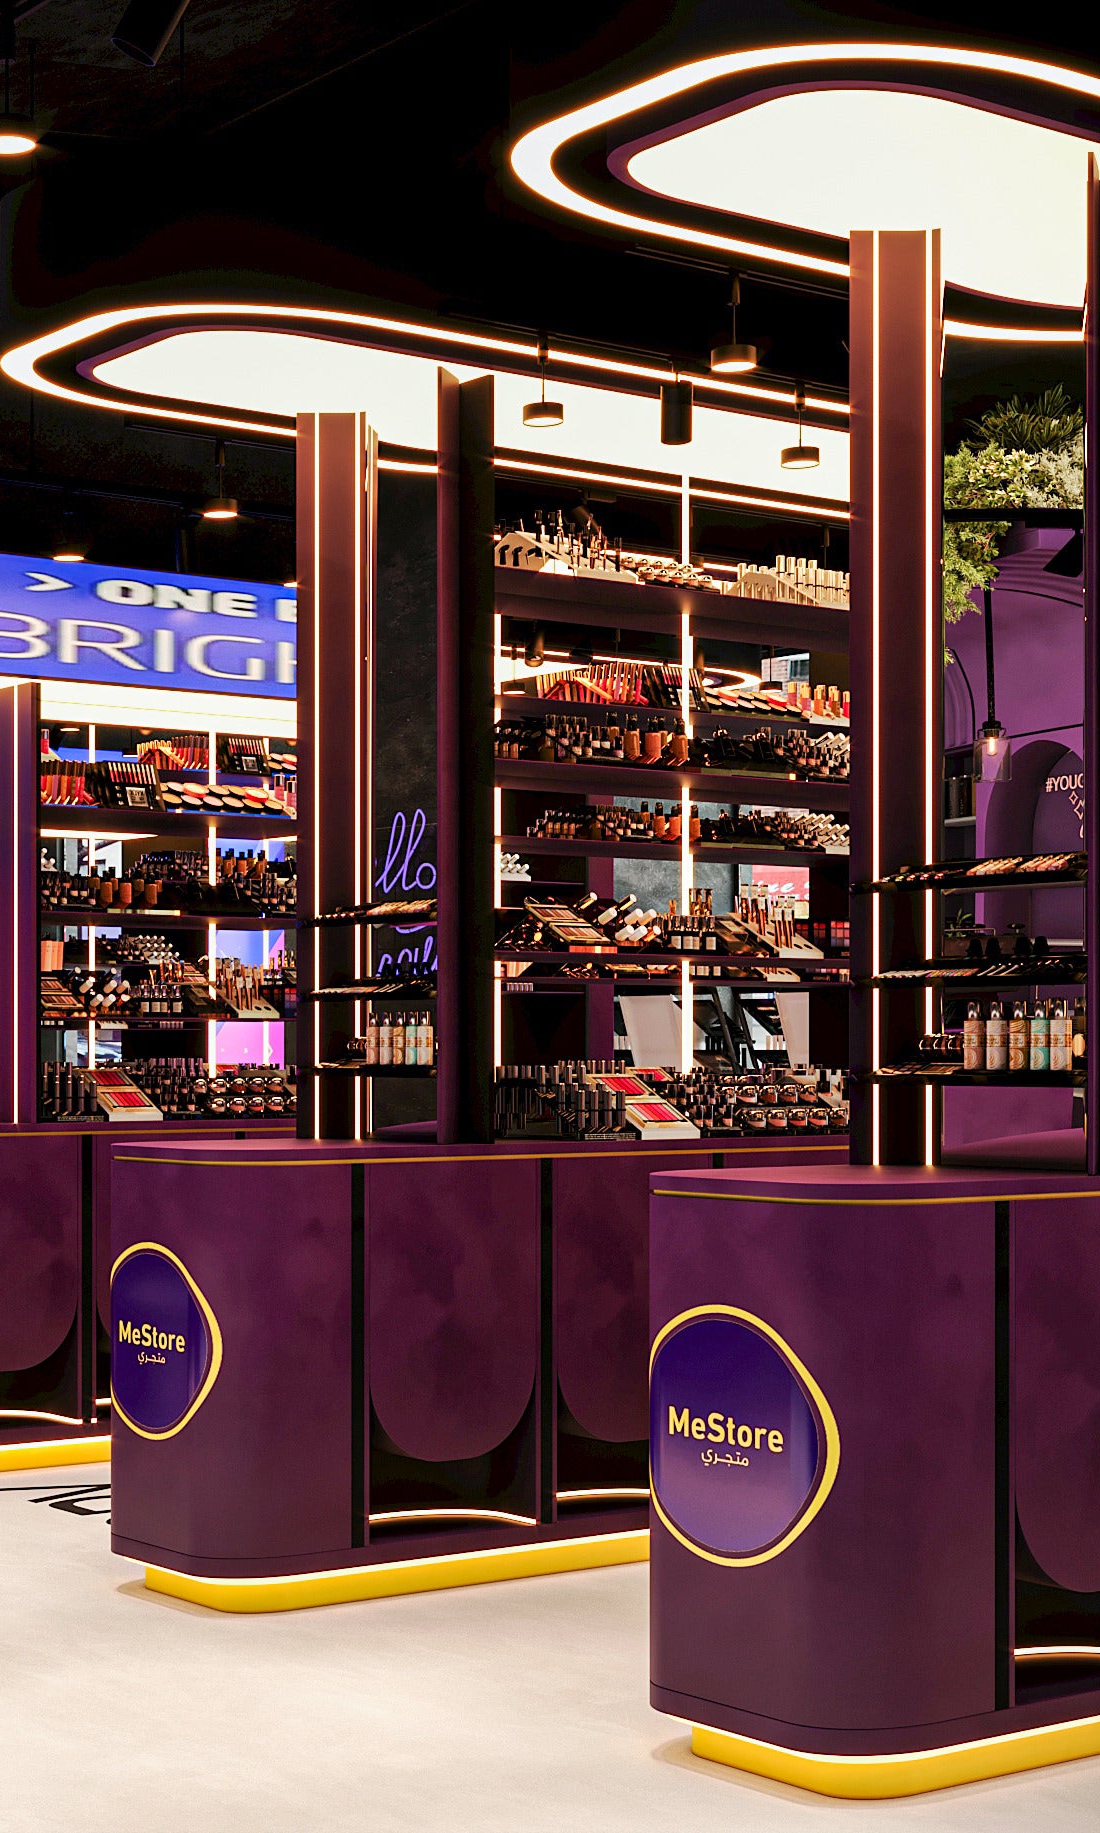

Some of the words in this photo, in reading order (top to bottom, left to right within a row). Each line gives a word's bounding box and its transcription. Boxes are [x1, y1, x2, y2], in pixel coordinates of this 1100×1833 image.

[97, 579, 259, 618] ONE
[118, 1319, 186, 1353] MeStore
[668, 1405, 784, 1453] MeStore
